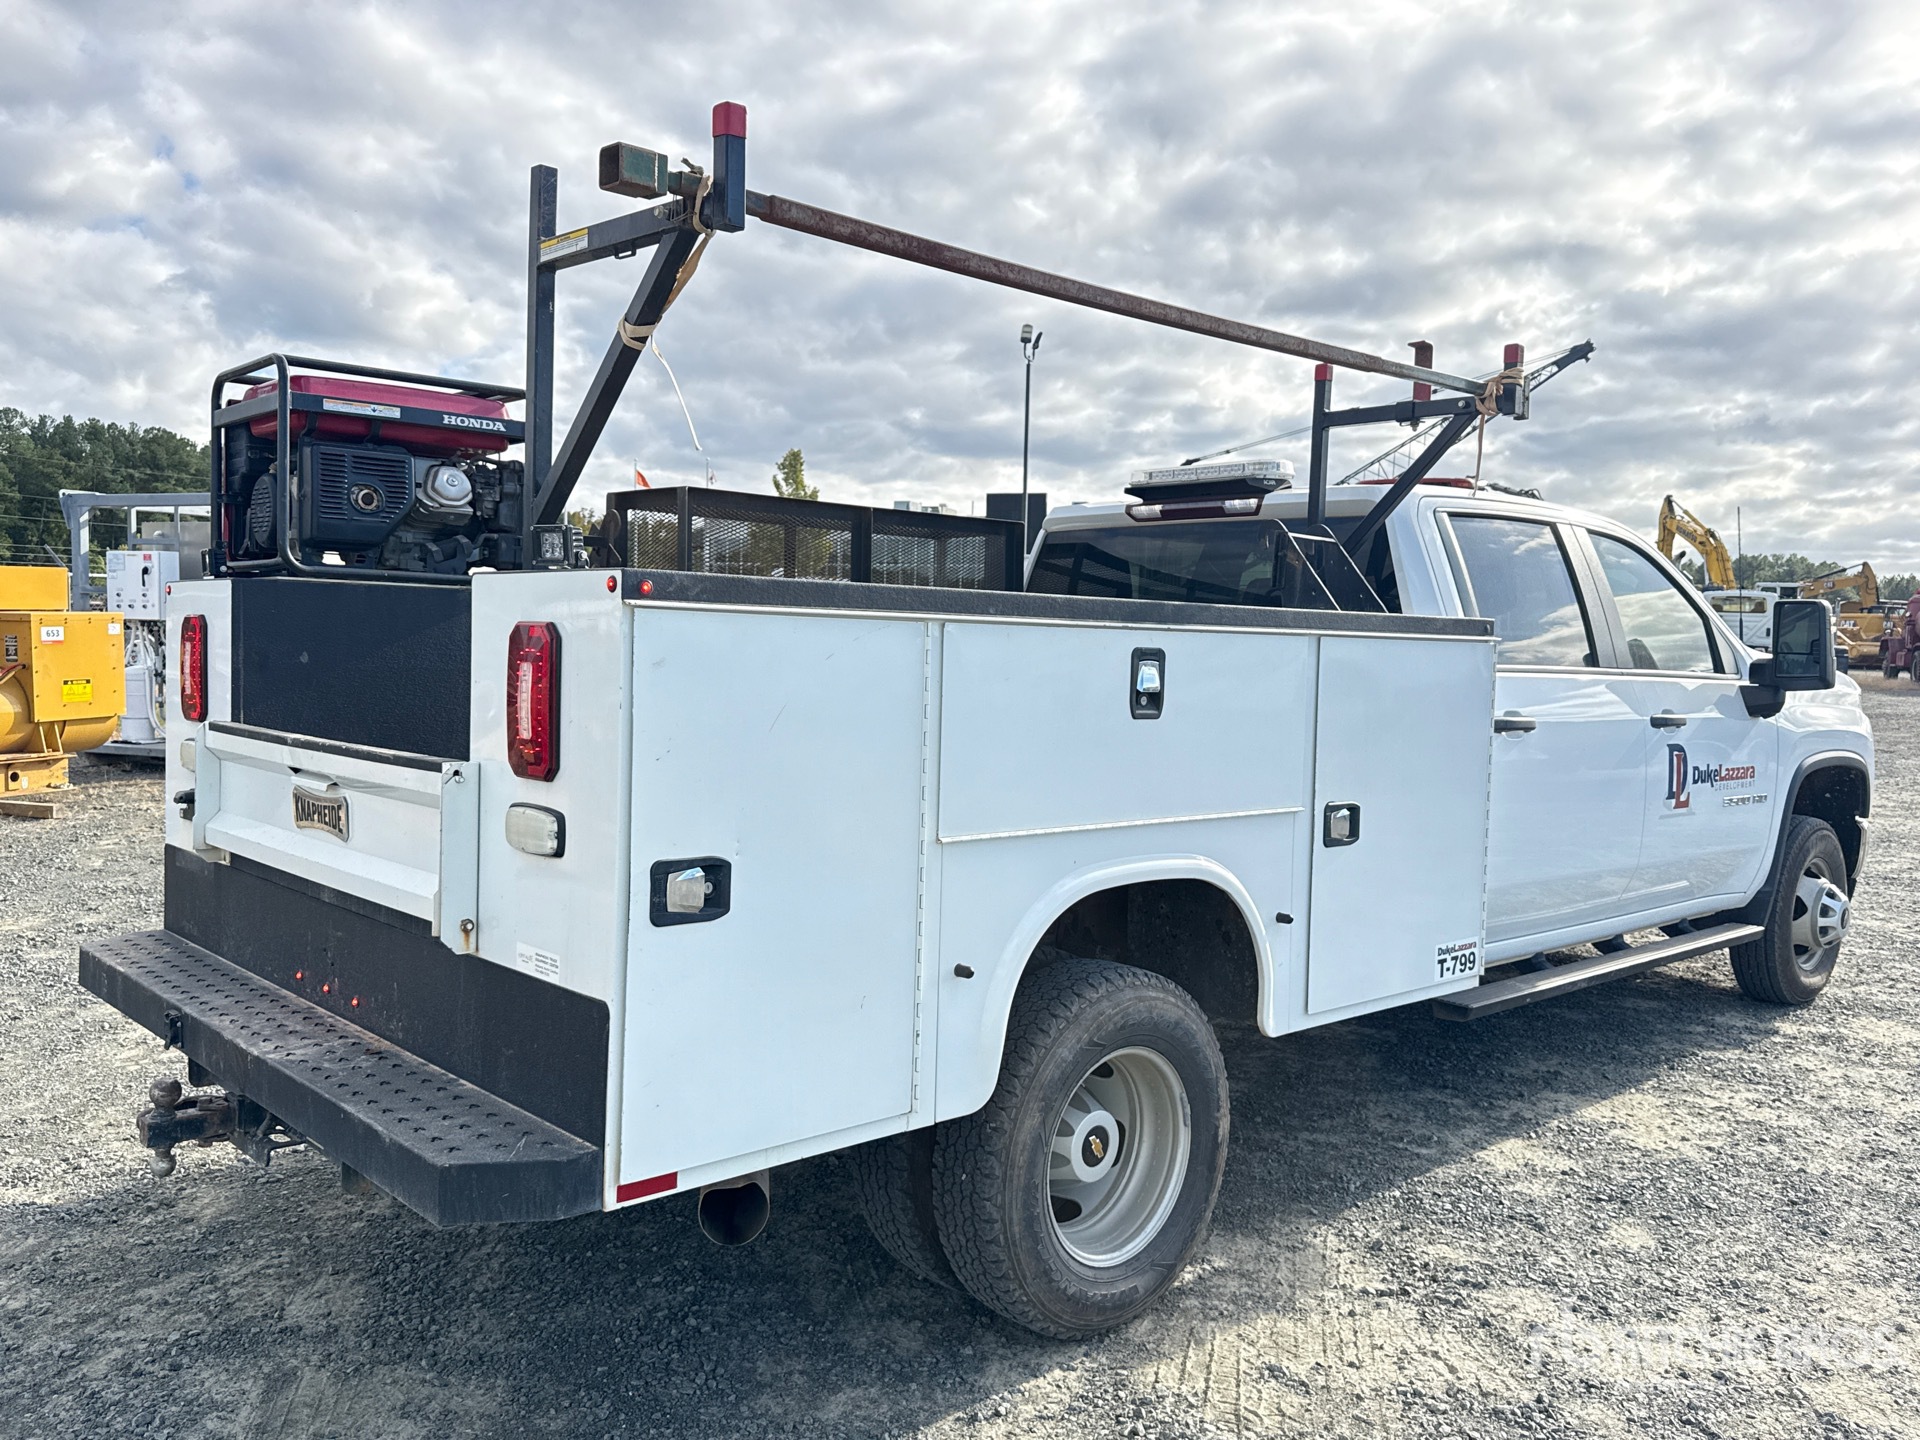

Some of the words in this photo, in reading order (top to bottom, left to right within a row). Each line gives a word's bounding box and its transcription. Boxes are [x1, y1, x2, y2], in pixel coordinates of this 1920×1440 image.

[443, 414, 507, 432] HONDA
[1840, 620, 1856, 628] CAT
[46, 629, 60, 638] 653
[1692, 764, 1756, 788] DukeLazzara
[1714, 780, 1756, 791] DEVELOPMENT
[295, 793, 344, 835] KNAPHEIDE
[1437, 951, 1476, 979] T-799
